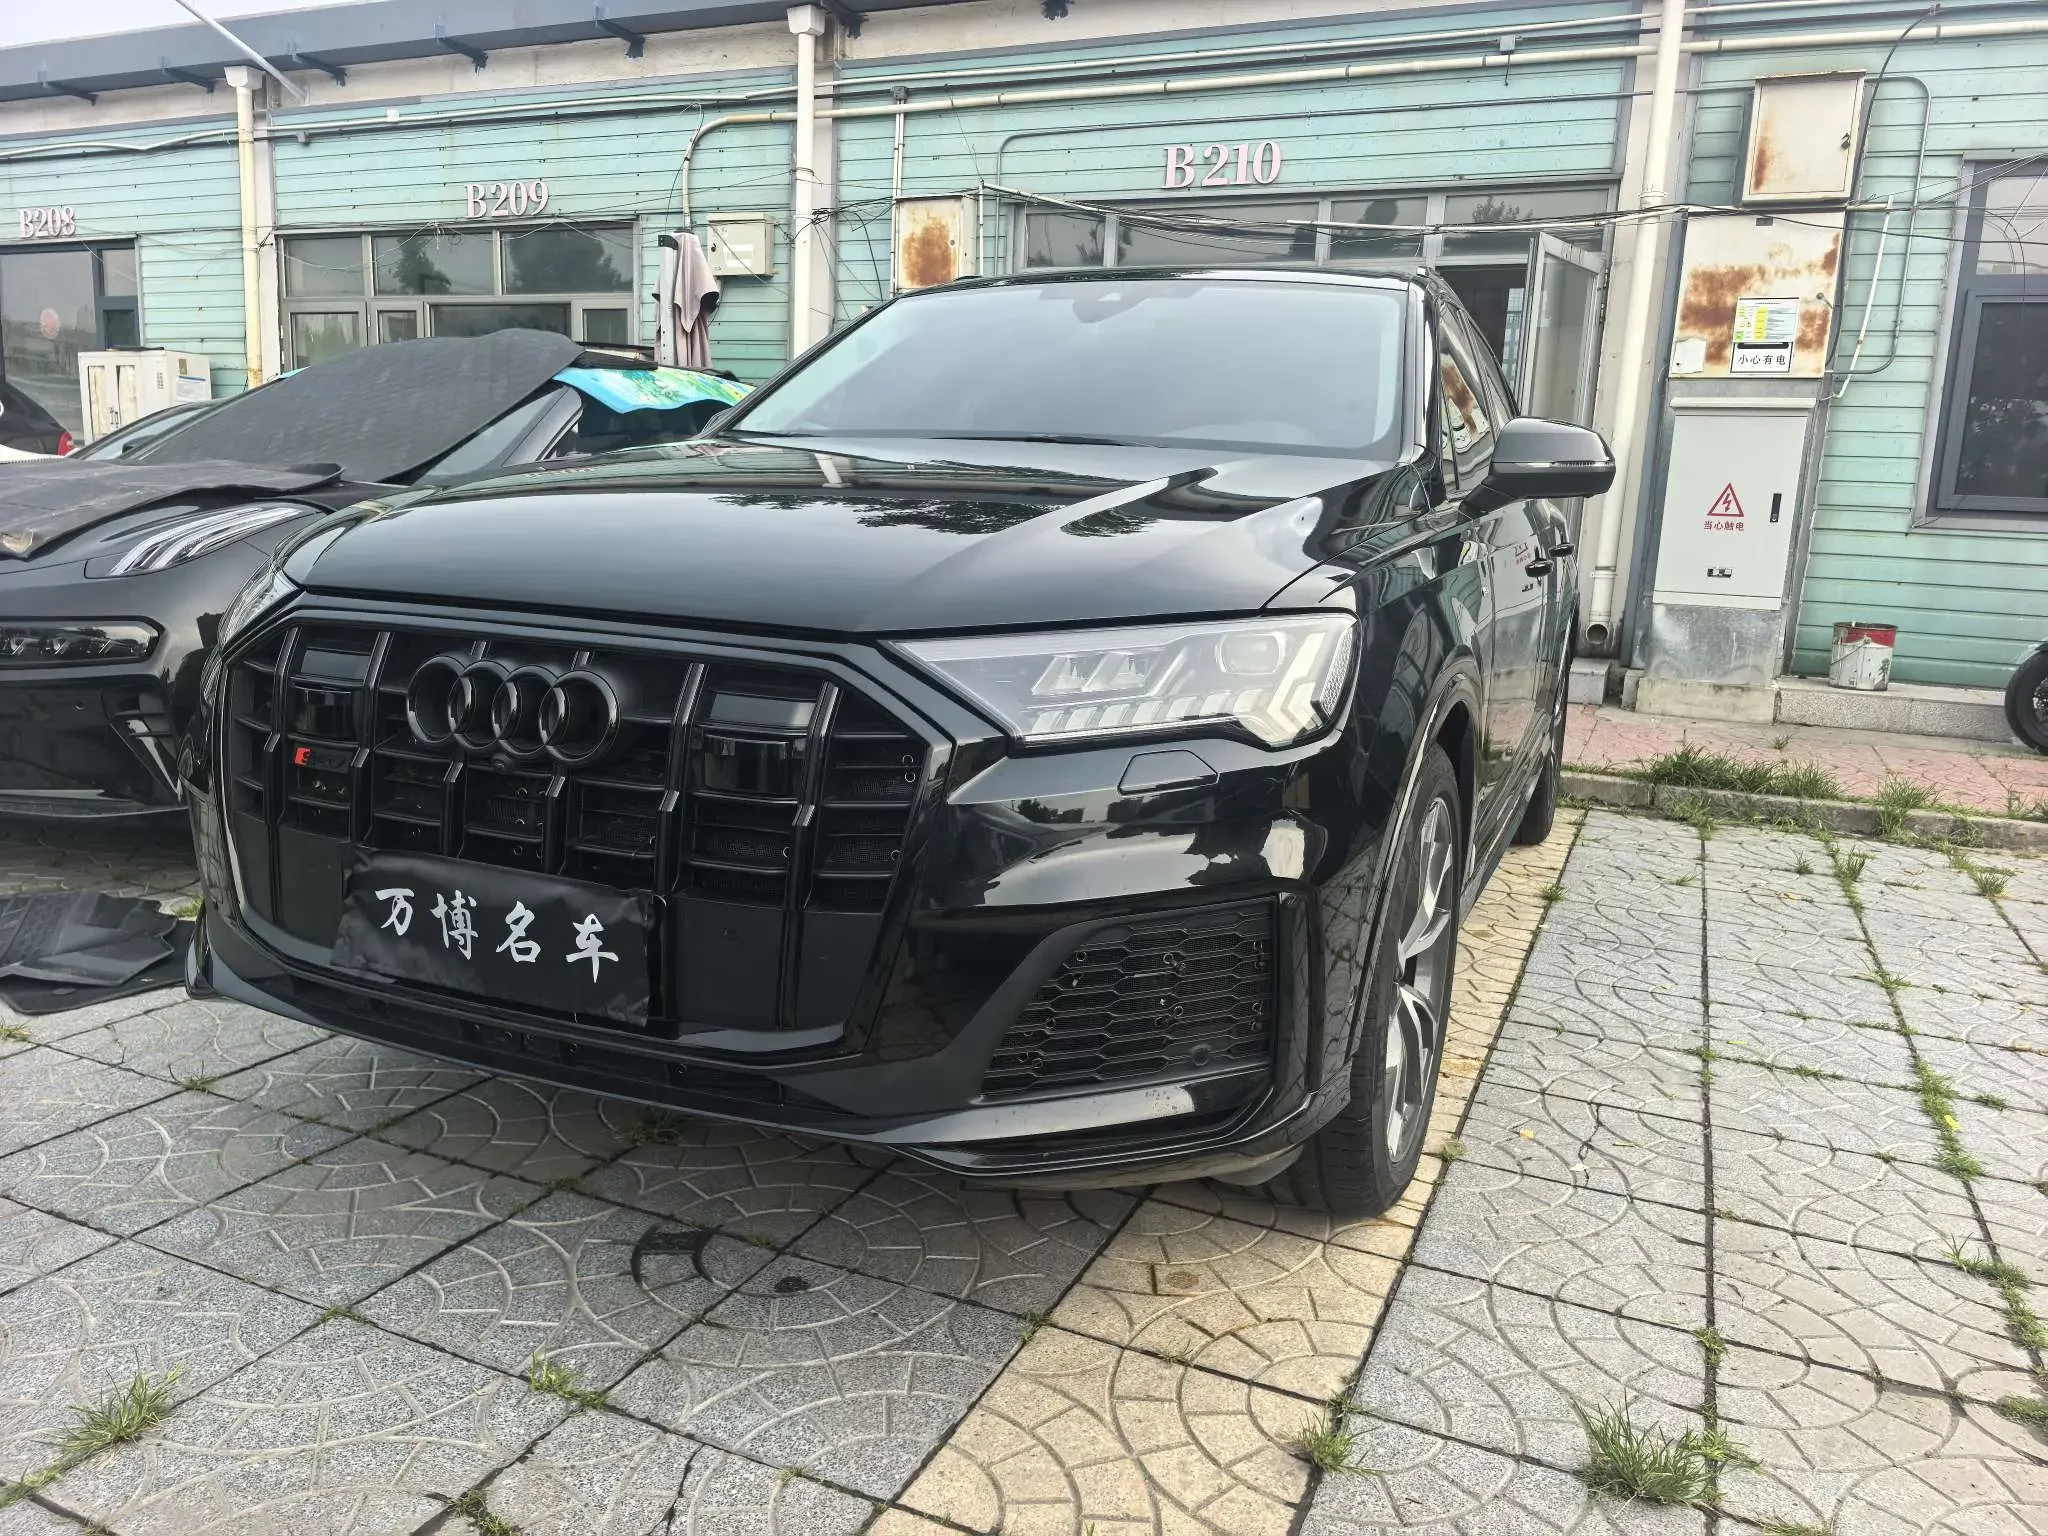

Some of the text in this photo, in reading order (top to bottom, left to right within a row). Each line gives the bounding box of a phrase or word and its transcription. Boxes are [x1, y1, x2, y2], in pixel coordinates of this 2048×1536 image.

[1161, 141, 1281, 188] B210
[465, 181, 549, 218] B209
[19, 206, 76, 238] B208
[1738, 354, 1786, 365] 小心有电
[1703, 520, 1745, 531] 当心触电
[374, 887, 620, 984] 万博名车
